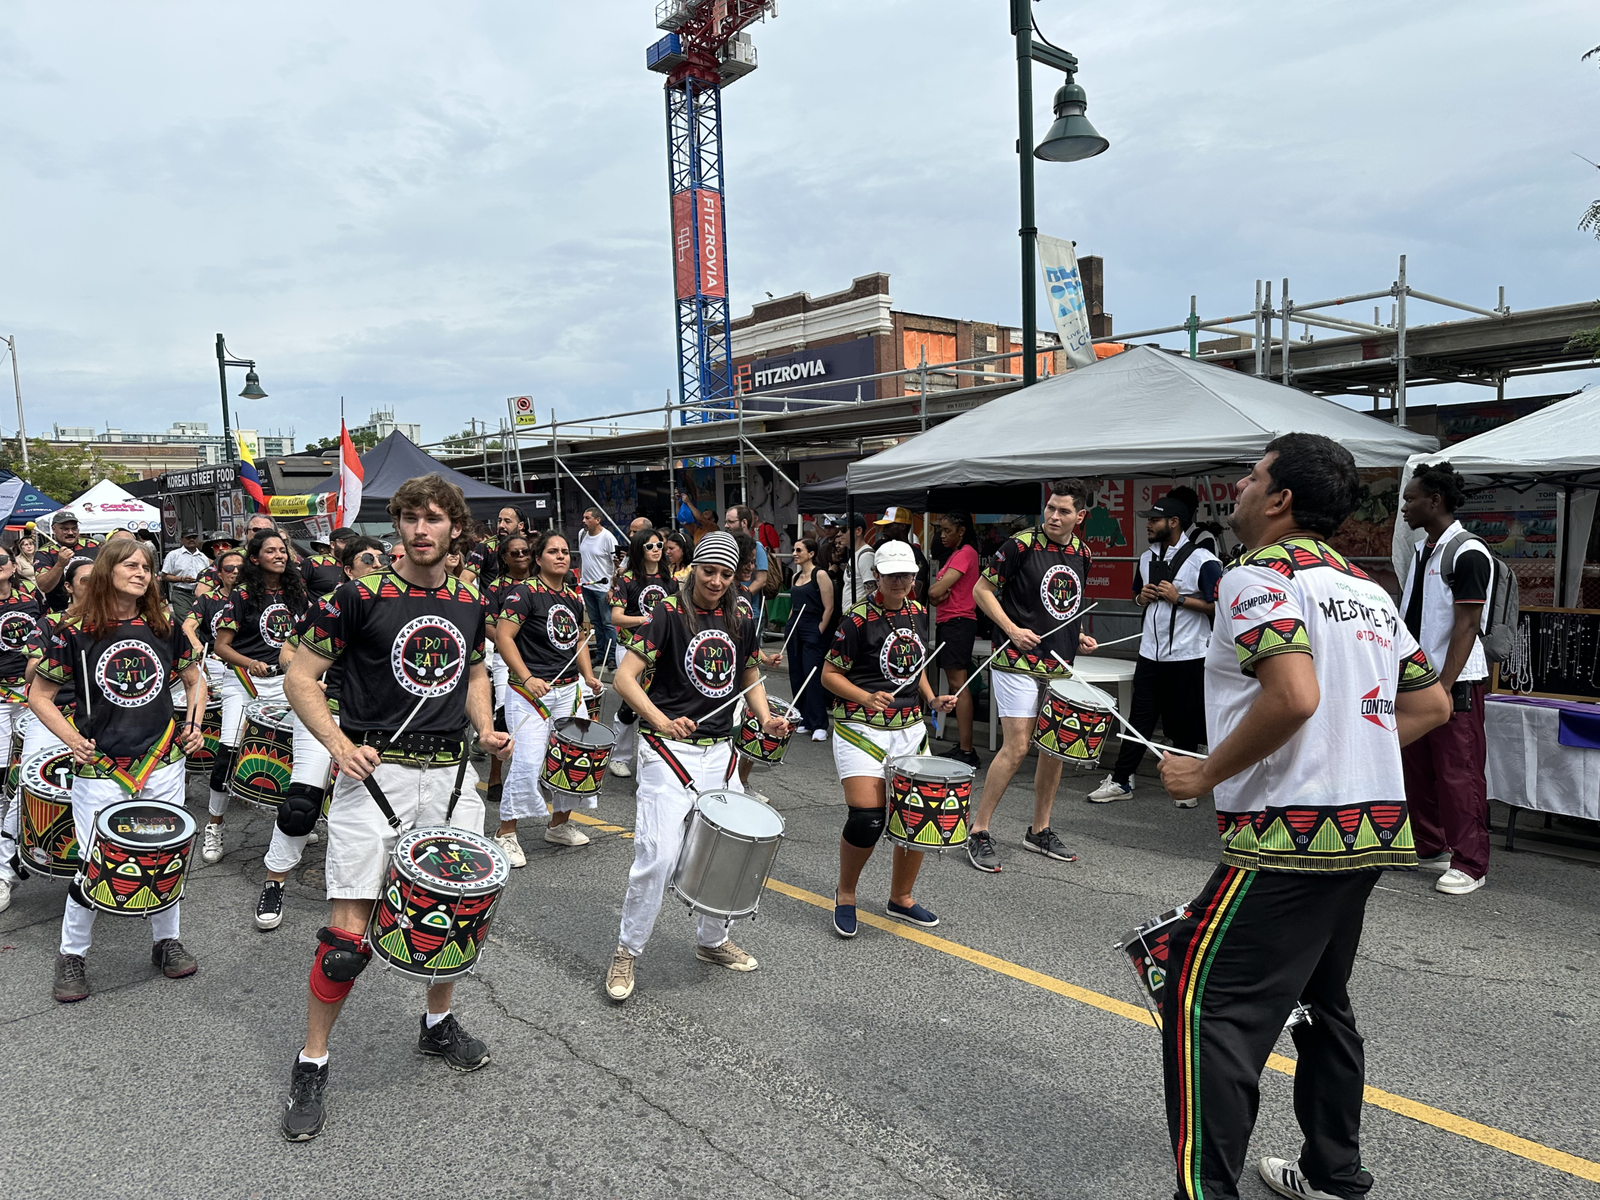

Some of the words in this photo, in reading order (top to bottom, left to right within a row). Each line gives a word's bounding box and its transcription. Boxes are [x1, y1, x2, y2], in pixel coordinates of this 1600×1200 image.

[703, 197, 718, 288] FITZROVIA
[1066, 328, 1081, 341] LIVE
[755, 359, 826, 387] FITZROVIA
[166, 473, 190, 489] KOREAN
[191, 469, 215, 486] STREET
[216, 467, 235, 483] FOOD
[1053, 588, 1072, 600] BATU
[8, 626, 29, 639] BATU
[272, 622, 292, 632] BATU
[557, 623, 574, 634] BATU
[413, 636, 450, 650] T.DOT
[700, 646, 728, 658] T.DOT
[112, 656, 146, 670] T.DOT
[415, 652, 449, 667] BATU
[703, 659, 729, 672] BATU
[896, 653, 917, 667] BATU
[116, 669, 147, 683] BATU
[428, 848, 475, 866] BATU
[439, 861, 488, 877] T.DOT
